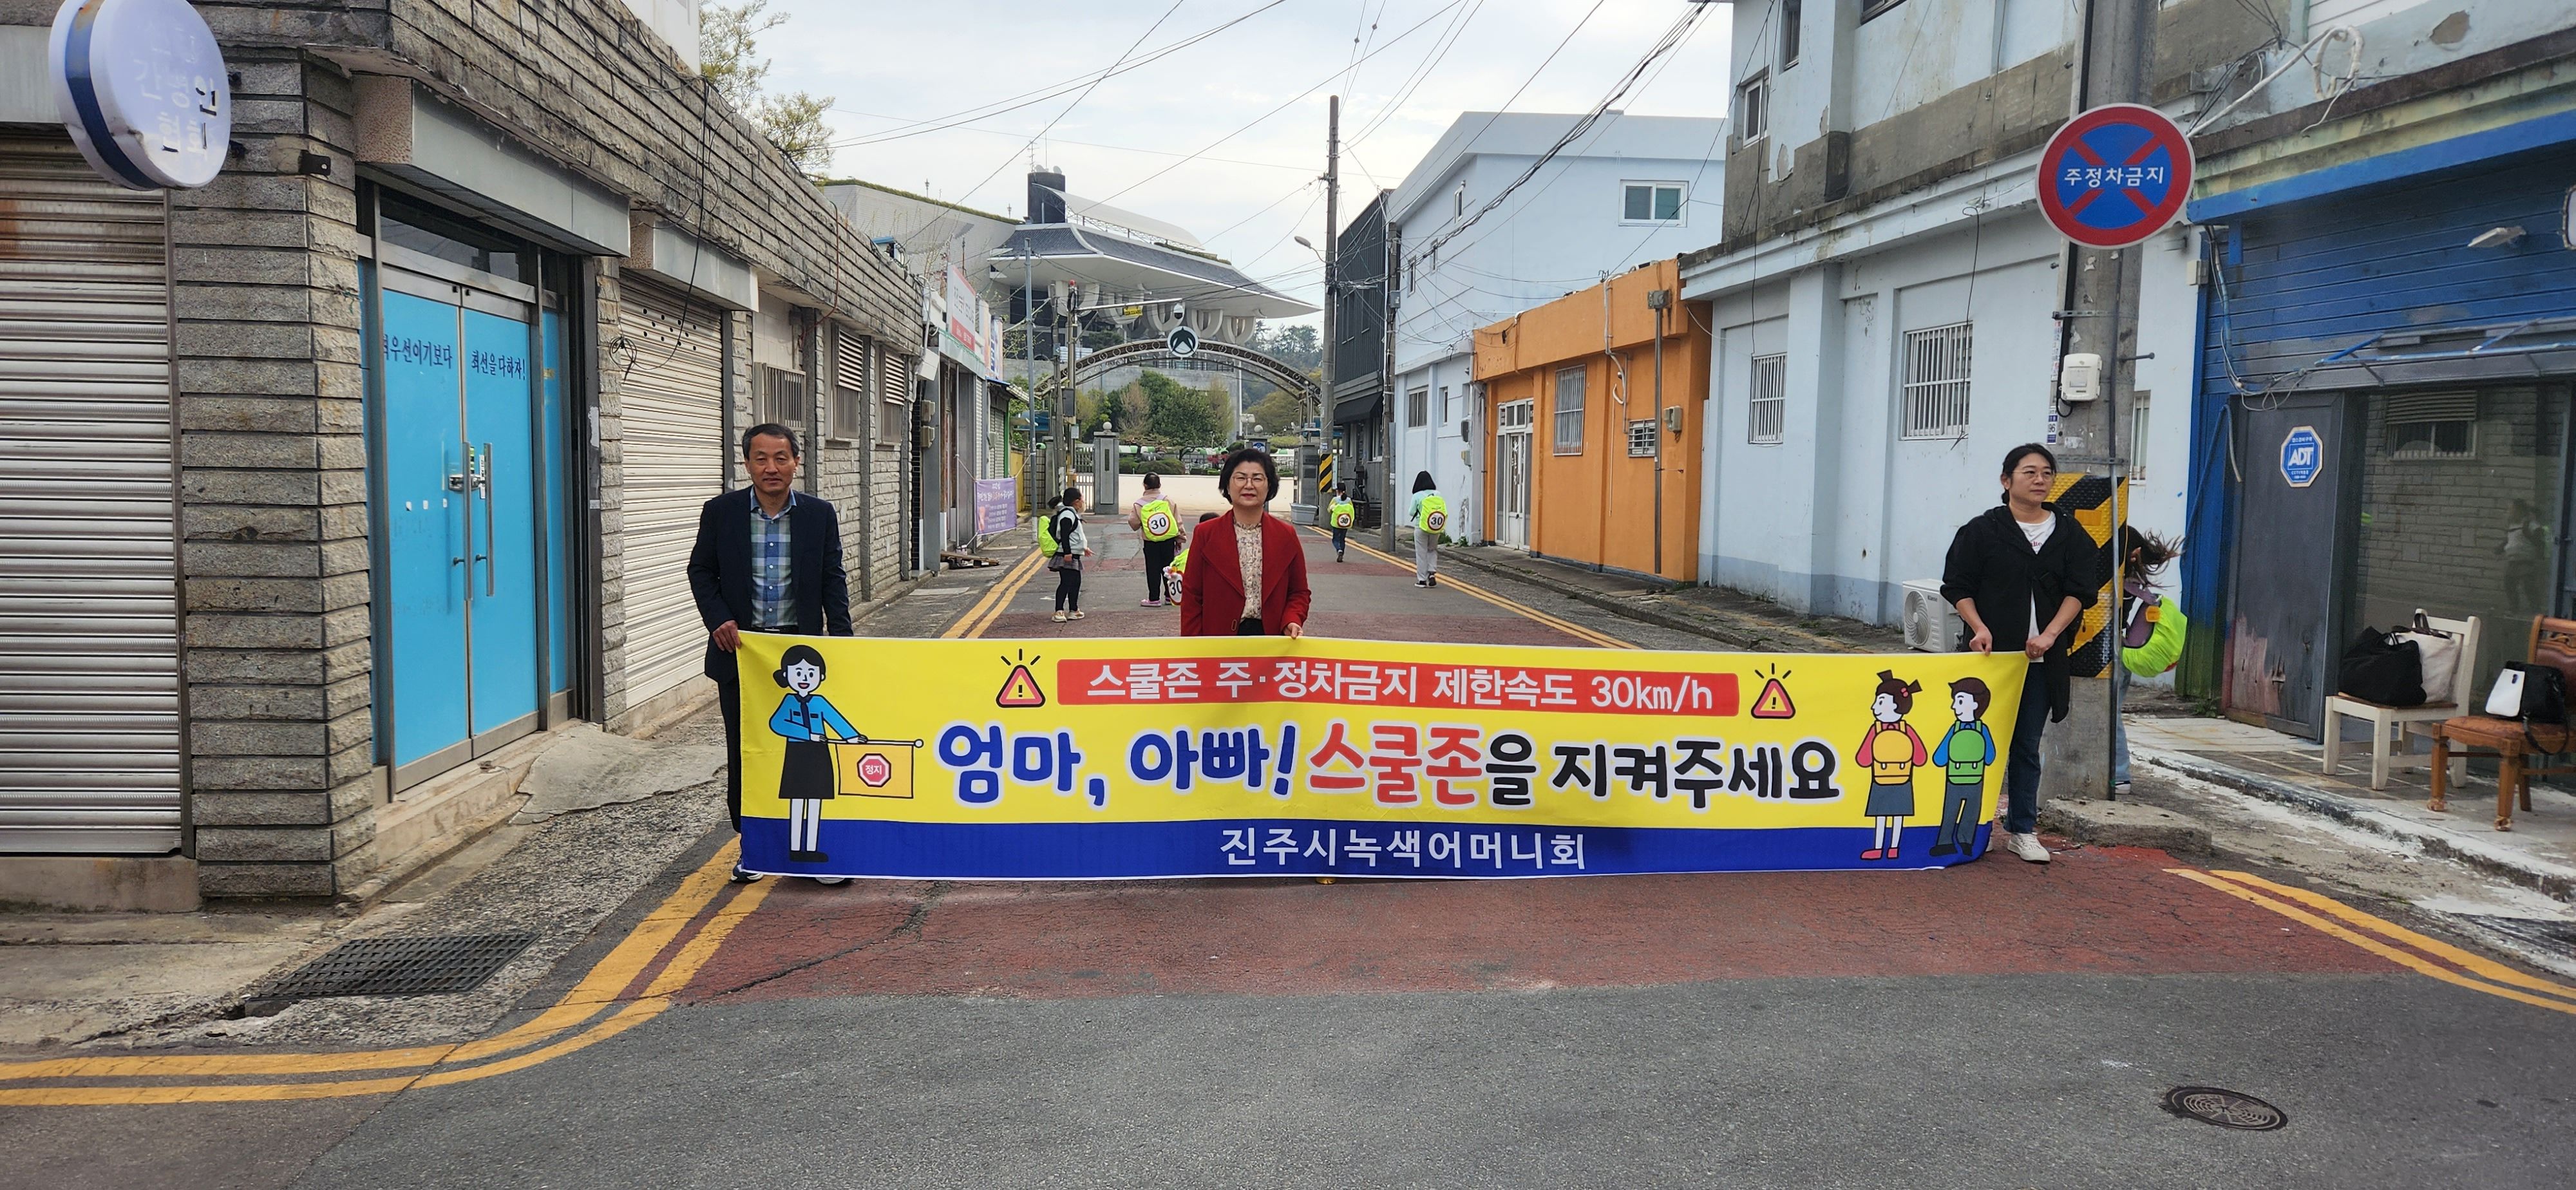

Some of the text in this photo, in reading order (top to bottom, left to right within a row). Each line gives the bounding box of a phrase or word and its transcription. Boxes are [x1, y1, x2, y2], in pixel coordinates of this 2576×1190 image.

[2065, 167, 2163, 187] 주정차금지
[471, 350, 526, 381] 최선을 다하자!
[2287, 447, 2314, 466] ADT
[1151, 517, 1166, 530] 30
[1430, 516, 1443, 525] 30
[1169, 580, 1182, 596] 30
[1087, 661, 1712, 712] 스쿨존 주·정차금지 제한속도 30km/h
[865, 765, 882, 775] 정지
[938, 724, 1841, 809] 엄마, 아빠! 스쿨존을 지켜주세요
[1220, 827, 1585, 869] 진주시녹색어머니회
